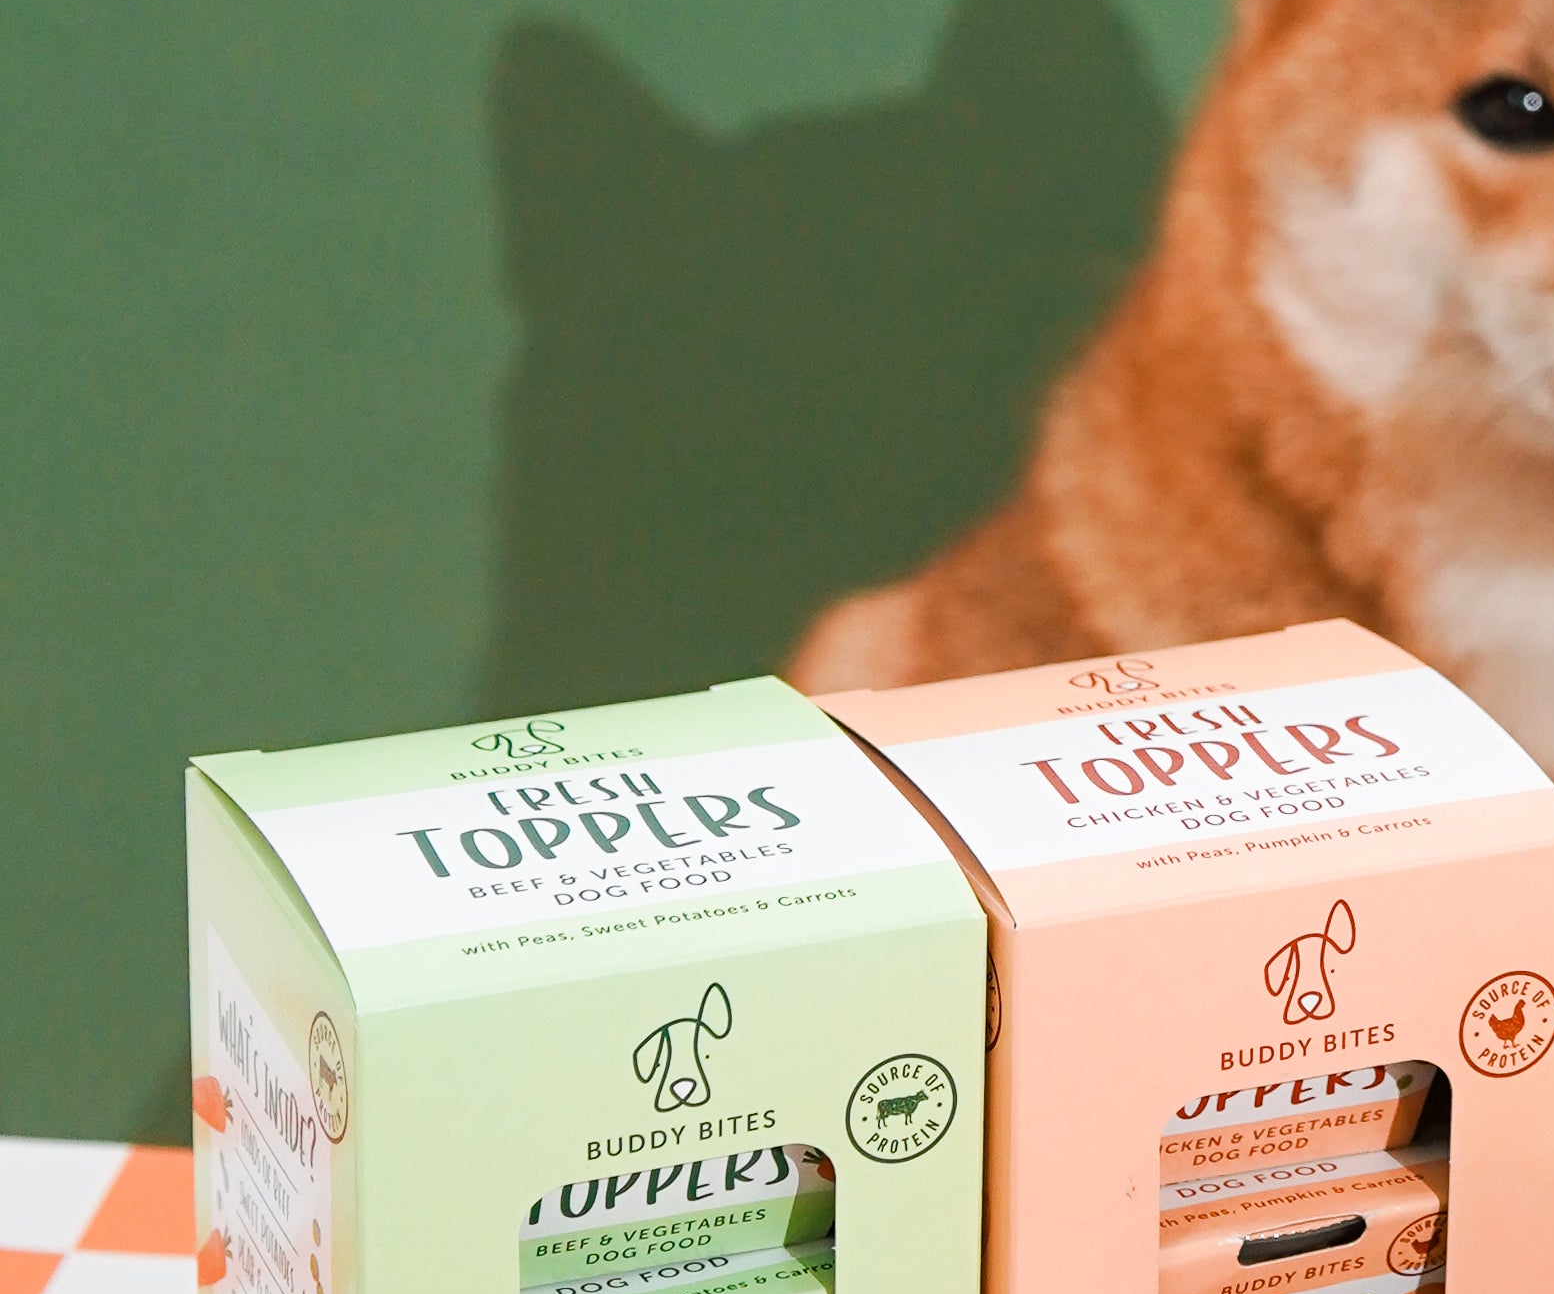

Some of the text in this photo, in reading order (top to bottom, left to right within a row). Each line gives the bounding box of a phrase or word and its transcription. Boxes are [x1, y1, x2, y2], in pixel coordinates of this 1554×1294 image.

[1056, 682, 1238, 716] BUDDY BITES
[1096, 704, 1263, 746] FRESH
[450, 747, 646, 781] BUDDY BITES
[1019, 715, 1400, 804] TOPPERS
[487, 772, 662, 815] FRESH
[1066, 765, 1431, 829] CHICKEN & VEGETABLES
[1180, 796, 1346, 830] DOG FOOD
[395, 786, 801, 877] TOPPERS
[1135, 817, 1432, 871] with Peas, Pumpkin & Carrots
[468, 842, 794, 899] BEEF & VEGETABLES
[554, 869, 733, 906] DOG FOOD
[461, 889, 858, 957] with Peas, Sweet Potatoes & Carrots
[1472, 980, 1551, 1020] SOURCE OF
[1220, 1023, 1395, 1071] BUDDY BITES
[1477, 1034, 1545, 1068] PROTEIN
[217, 989, 317, 1184] WHAT'S INSIDE?
[859, 1063, 945, 1105] SOURCE OF
[587, 1109, 776, 1161] BUDDY BITES
[866, 1118, 940, 1154] PROTEIN
[1159, 1109, 1384, 1155] ICKEN & VEGETABLES
[1192, 1137, 1309, 1167] DOG FOOD
[1176, 1162, 1338, 1199] DOG FOOD
[1184, 1209, 1236, 1223] Peas,
[1240, 1188, 1327, 1212] Pumpkin
[1333, 1184, 1345, 1194] &
[1351, 1174, 1425, 1191] Carrots
[536, 1208, 767, 1257] BEEF & VEGETABLES
[585, 1234, 712, 1265] DOG FOOD
[639, 1256, 730, 1283] FOOD
[754, 1274, 767, 1285] &
[775, 1260, 835, 1280] Carro
[1304, 1256, 1366, 1280] BITES
